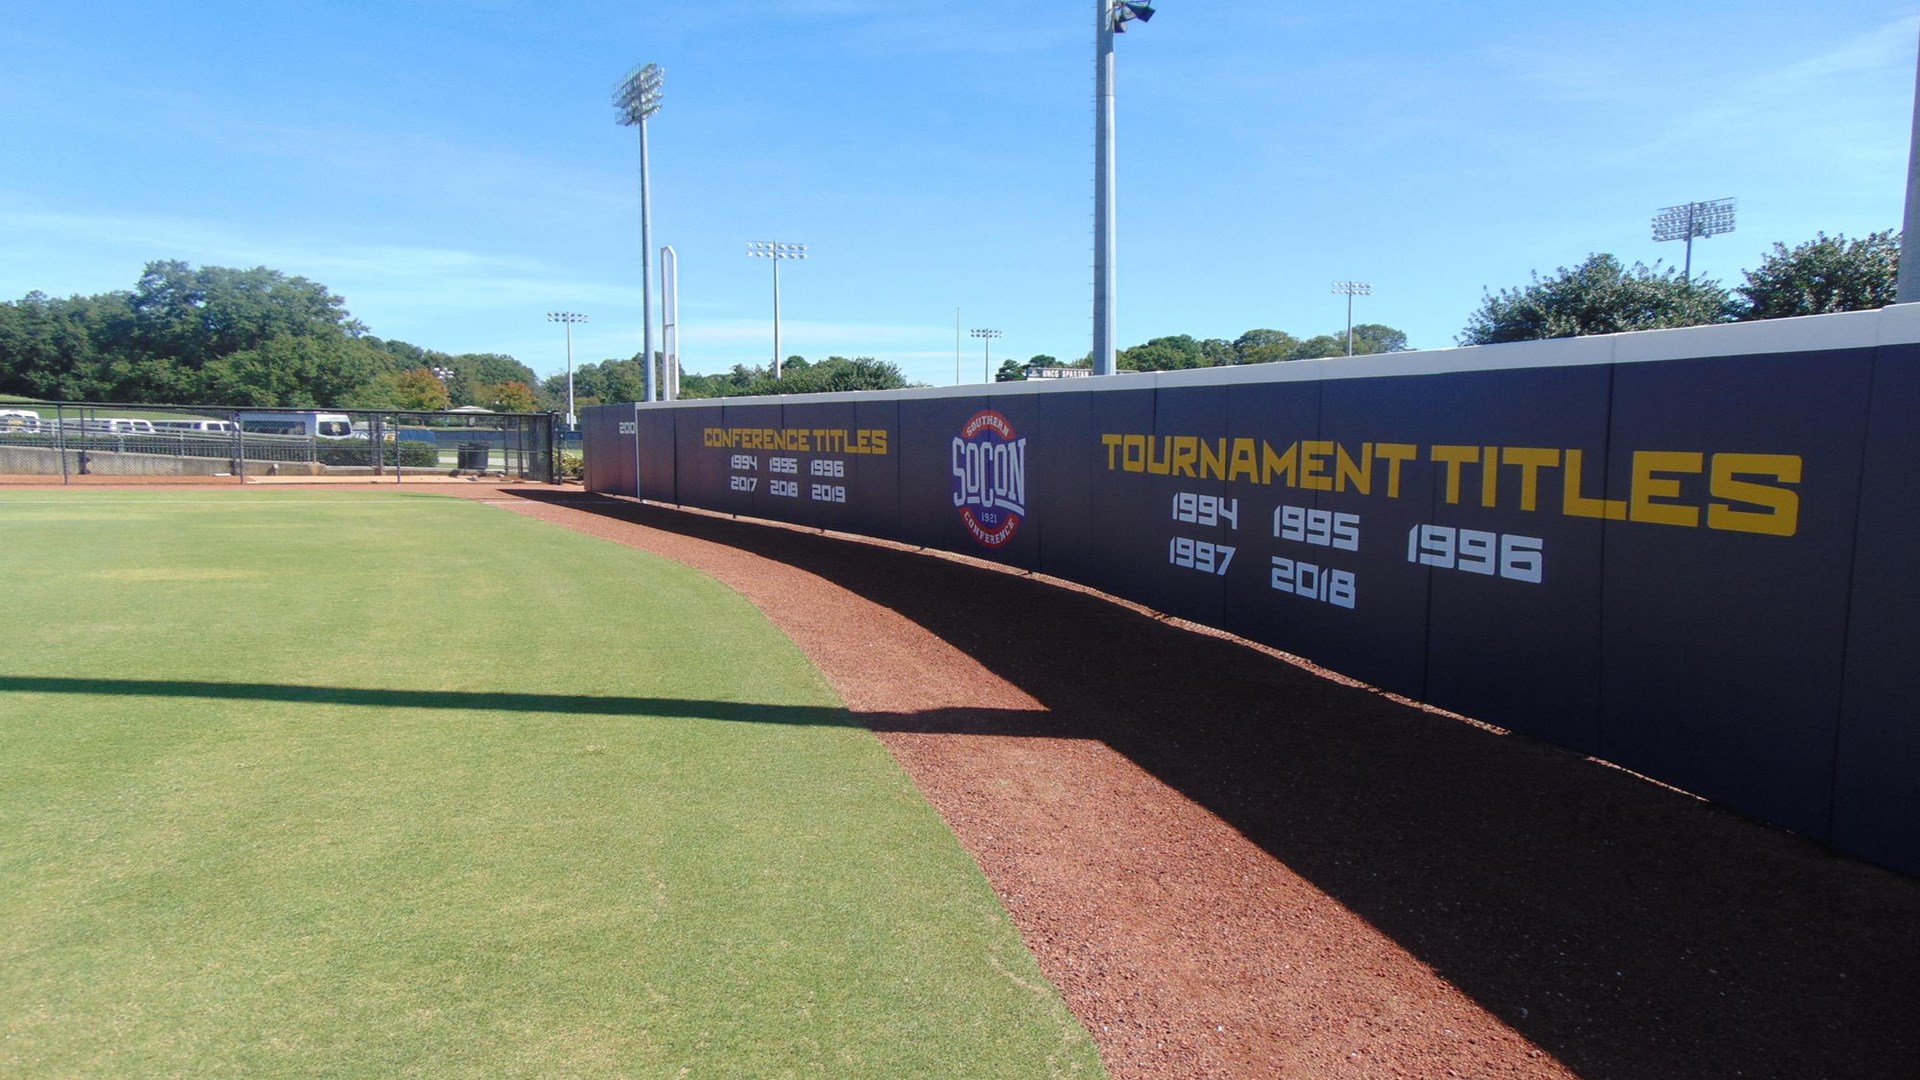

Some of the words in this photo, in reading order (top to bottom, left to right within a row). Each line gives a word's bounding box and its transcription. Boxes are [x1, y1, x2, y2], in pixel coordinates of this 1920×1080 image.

[703, 428, 809, 451] CONFERENCE
[812, 429, 888, 455] TITLES
[966, 415, 1010, 437] SOUTHERN
[731, 454, 758, 471] 1994
[769, 456, 798, 474] 1995
[810, 459, 844, 478] 1996
[952, 436, 1027, 508] SOCON
[730, 475, 758, 492] 2017
[769, 479, 798, 498] 2018
[811, 483, 846, 503] 2019
[1101, 433, 1418, 499] TOURNAMENT
[1430, 445, 1803, 537] TITLES
[963, 510, 1016, 545] CONFERENCE
[981, 511, 998, 524] 1921
[1171, 491, 1239, 530] 1994
[1272, 504, 1361, 552] 1995
[1407, 523, 1544, 584] 1996
[1168, 536, 1237, 576] 1997
[1270, 555, 1358, 610] 2018
